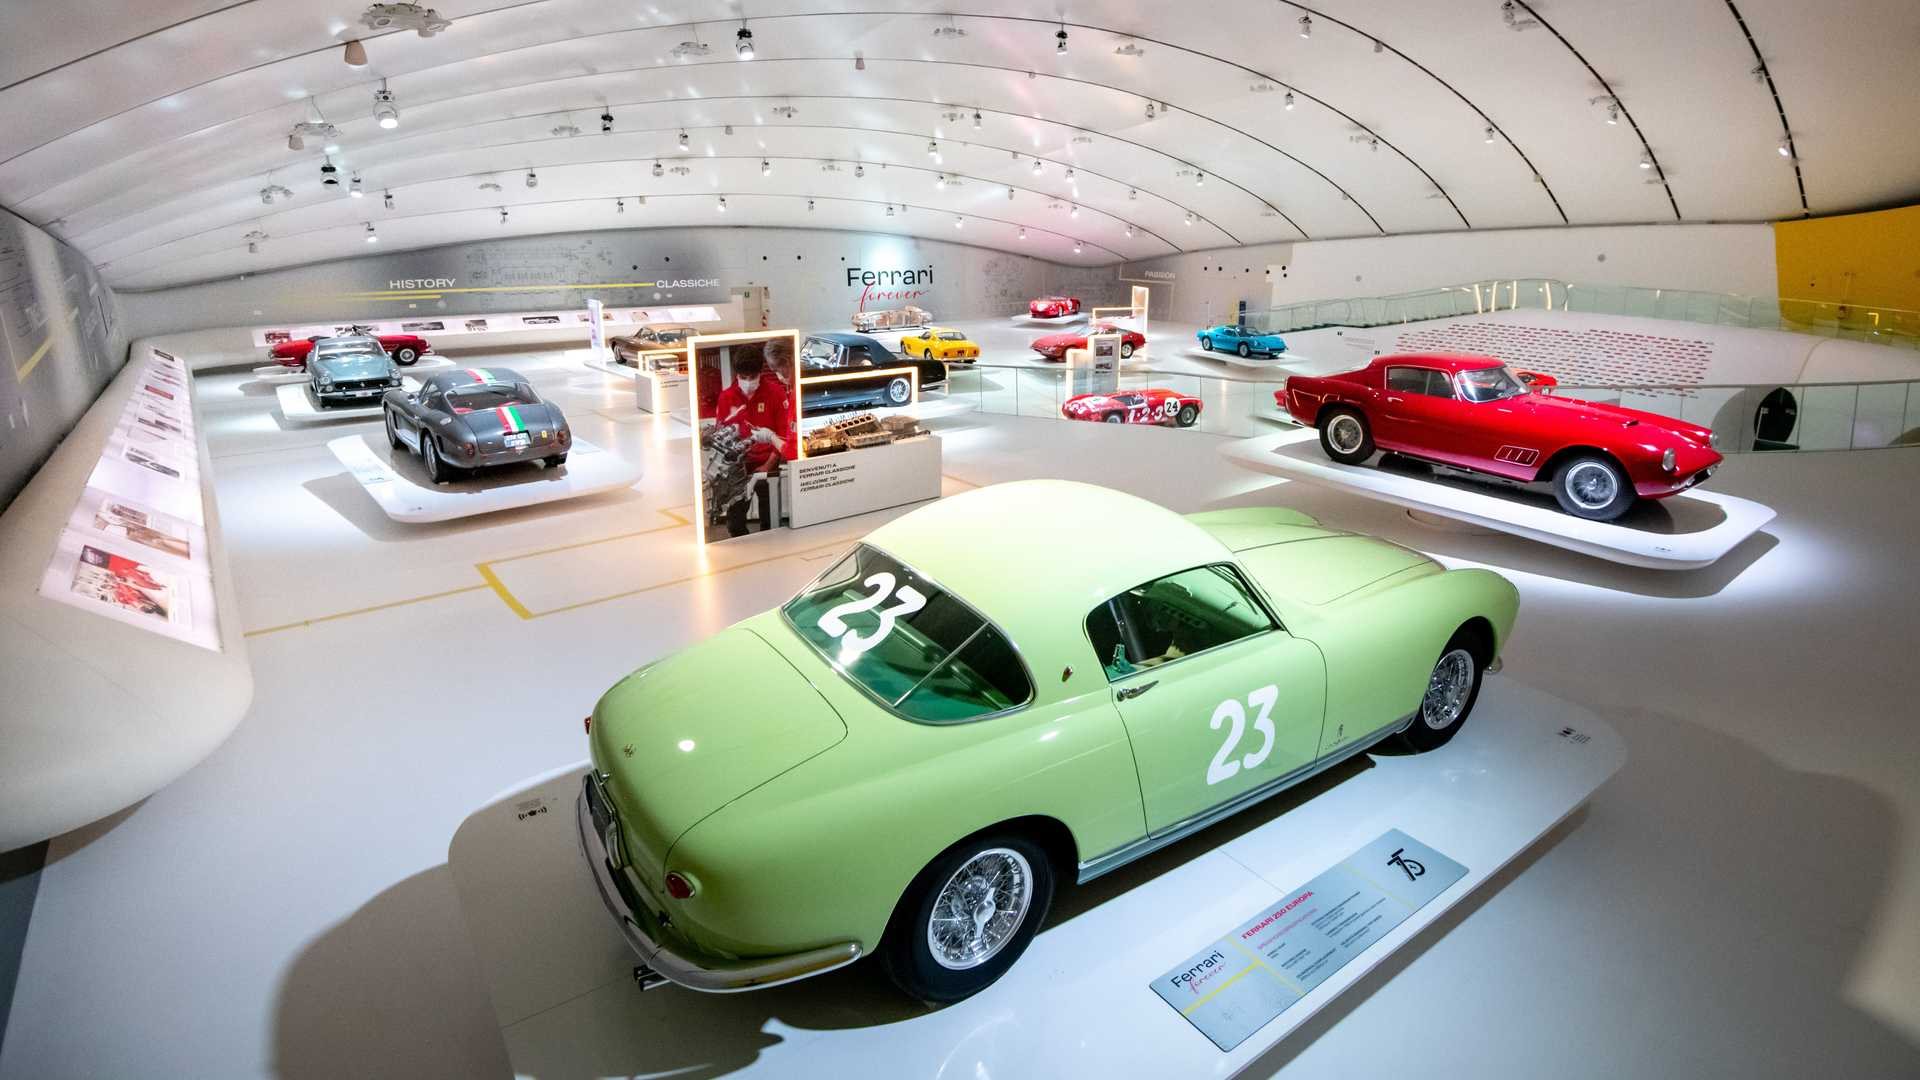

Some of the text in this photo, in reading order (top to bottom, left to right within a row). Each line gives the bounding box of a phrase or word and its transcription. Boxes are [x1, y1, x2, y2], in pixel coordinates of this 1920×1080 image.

[846, 265, 933, 286] Ferrari
[389, 278, 456, 289] HISTORY
[656, 279, 720, 289] CLASSICHE
[854, 284, 929, 312] forever
[1166, 401, 1178, 413] 24
[799, 463, 832, 474] BENVENUTI
[799, 470, 824, 479] FERRARI
[800, 477, 829, 487] WELCOME
[800, 484, 825, 492] FERRARI
[817, 572, 927, 653] 23
[1206, 684, 1279, 785] 23
[1241, 917, 1274, 939] FERRARI
[1272, 908, 1287, 919] 250
[1285, 890, 1314, 911] EUROPA
[1170, 950, 1225, 988] Ferrari
